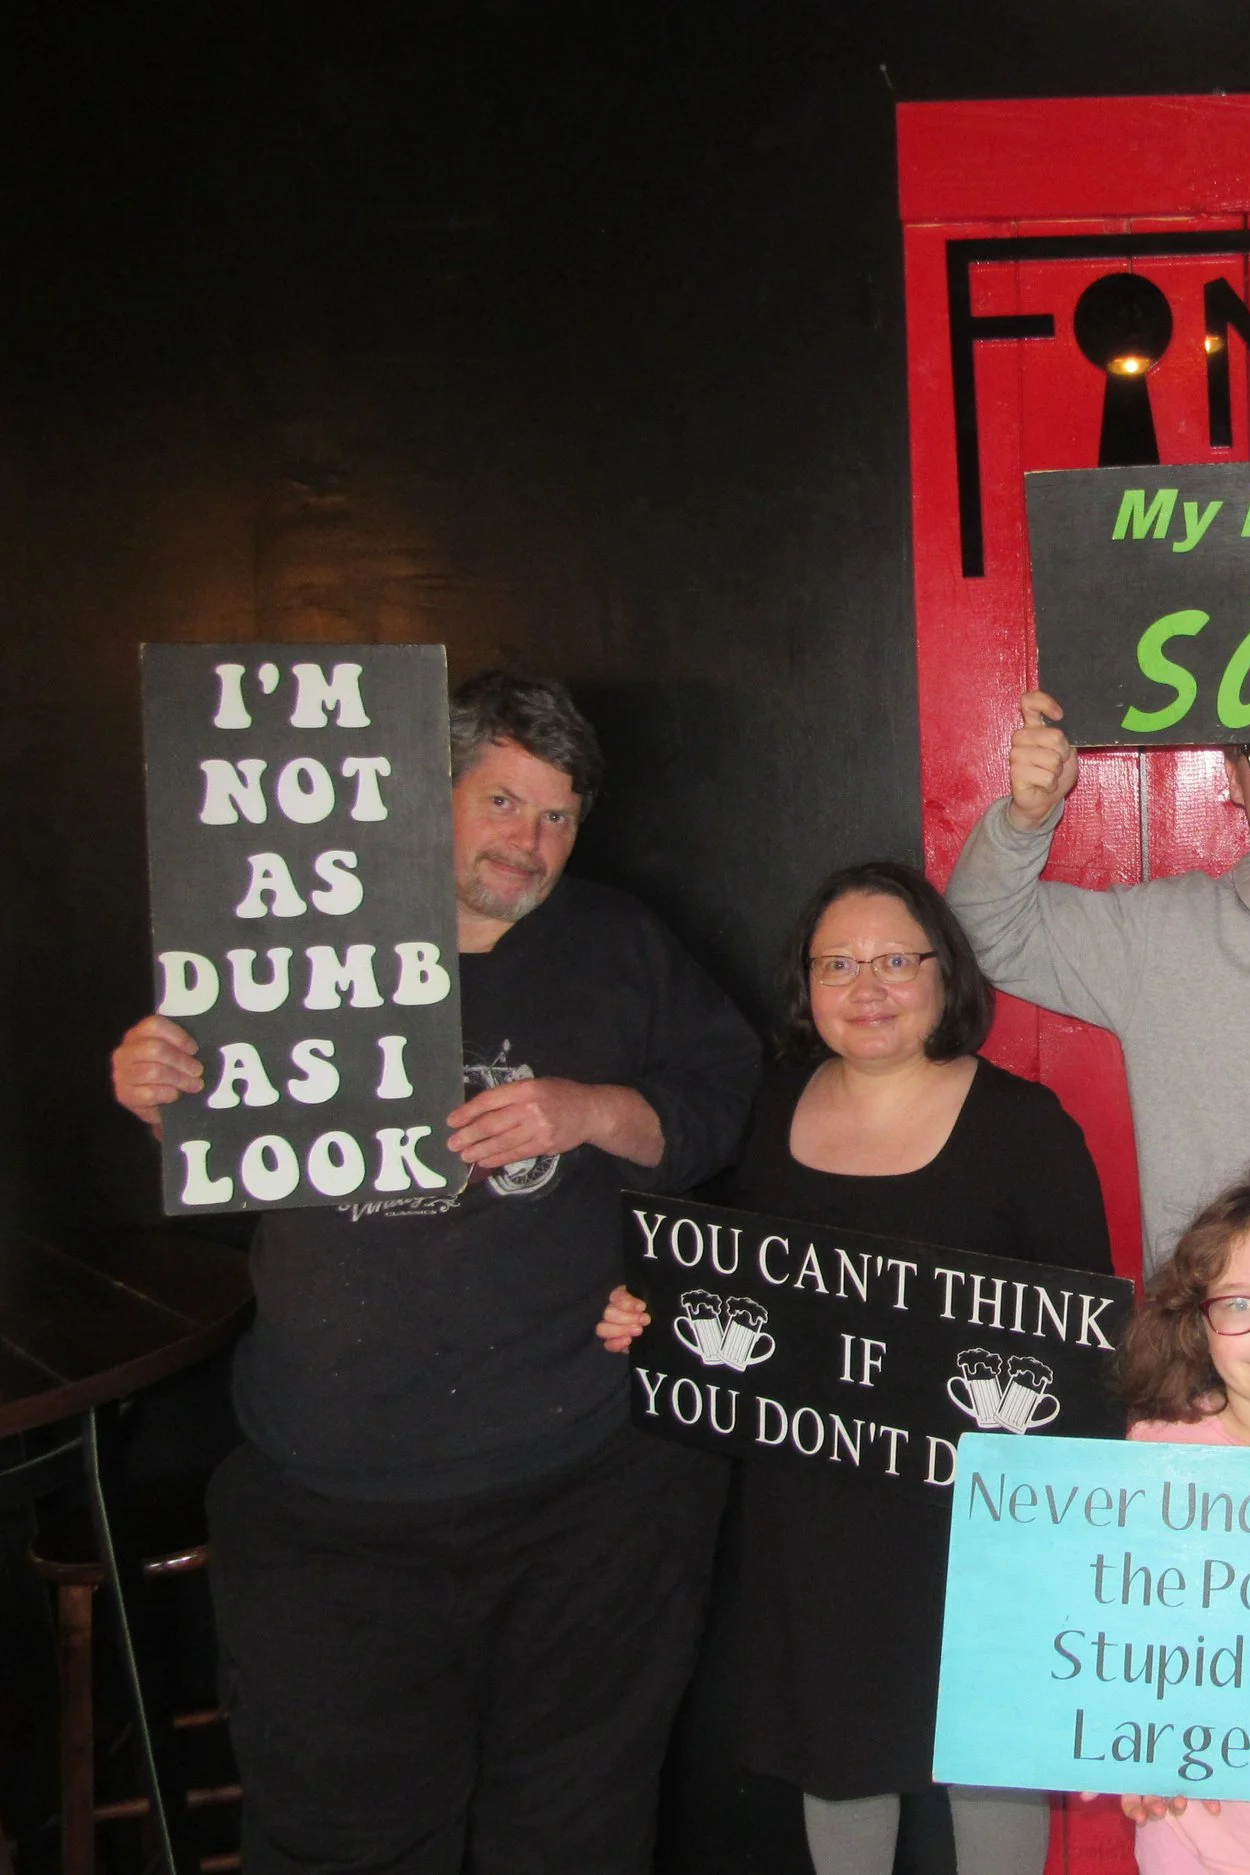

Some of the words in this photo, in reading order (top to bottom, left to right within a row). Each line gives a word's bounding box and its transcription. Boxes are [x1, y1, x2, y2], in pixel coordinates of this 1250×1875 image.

[1112, 488, 1221, 553] My
[214, 663, 370, 729] I'M
[200, 757, 391, 825] NOT
[236, 850, 364, 918] AS
[158, 942, 451, 1016] DUMB
[207, 1039, 340, 1109] AS
[377, 1035, 414, 1099] I
[181, 1126, 446, 1205] LOOK
[632, 1209, 743, 1275] YOU
[759, 1235, 918, 1311] CAN'T
[934, 1267, 1116, 1351] THINK
[839, 1334, 887, 1387] IF
[634, 1368, 741, 1434] YOU
[755, 1396, 909, 1477] DON'T
[968, 1471, 1146, 1528] Never
[1090, 1552, 1186, 1608] the
[1050, 1630, 1244, 1700] Stupid
